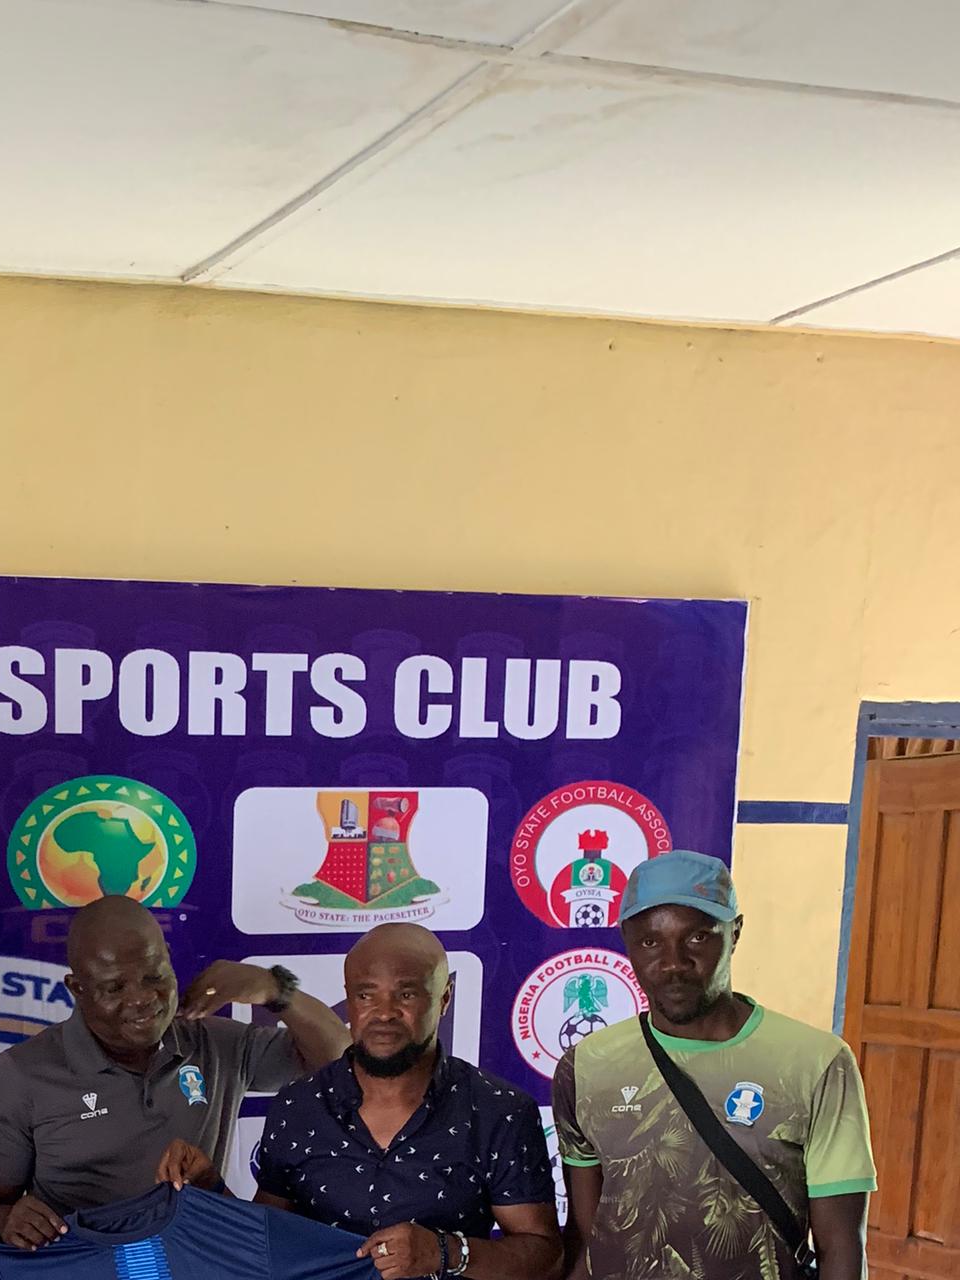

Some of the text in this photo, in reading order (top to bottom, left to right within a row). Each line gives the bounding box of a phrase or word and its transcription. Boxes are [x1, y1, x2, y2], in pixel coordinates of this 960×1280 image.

[394, 654, 622, 740] CLUB
[550, 786, 637, 809] FOOTBALL
[515, 805, 551, 850] STATE
[513, 854, 530, 887] OYO
[298, 908, 317, 918] OYO
[352, 914, 371, 923] THE
[373, 906, 430, 922] PACESETTER
[518, 983, 539, 1041] NIGERIA
[537, 954, 609, 983] FOOTBALL
[80, 1107, 109, 1120] cone
